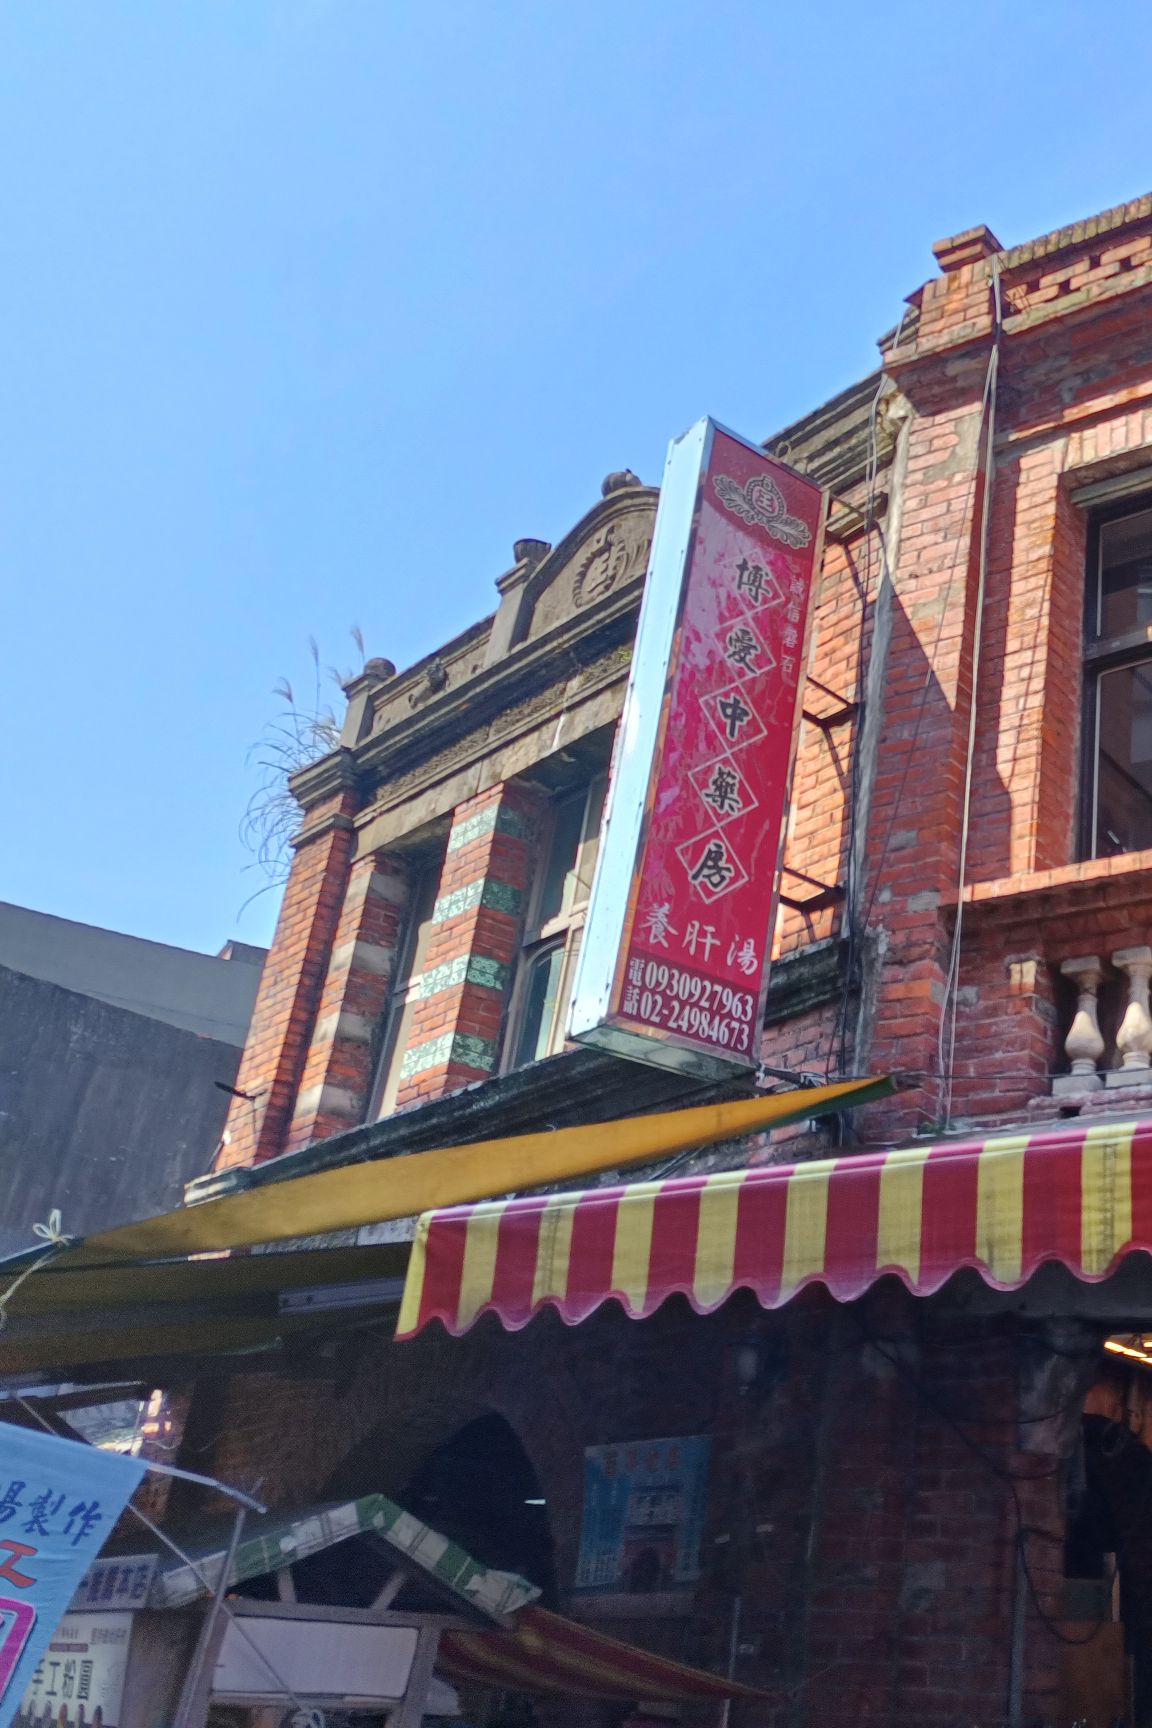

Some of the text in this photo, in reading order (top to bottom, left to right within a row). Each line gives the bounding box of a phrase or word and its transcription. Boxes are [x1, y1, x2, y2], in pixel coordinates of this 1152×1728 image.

[690, 557, 771, 893] 博愛中藥房
[639, 903, 759, 976] 養肝湯
[623, 957, 645, 1016] 電話
[645, 962, 753, 1022] 0930927963
[639, 991, 749, 1051] 02-24984673
